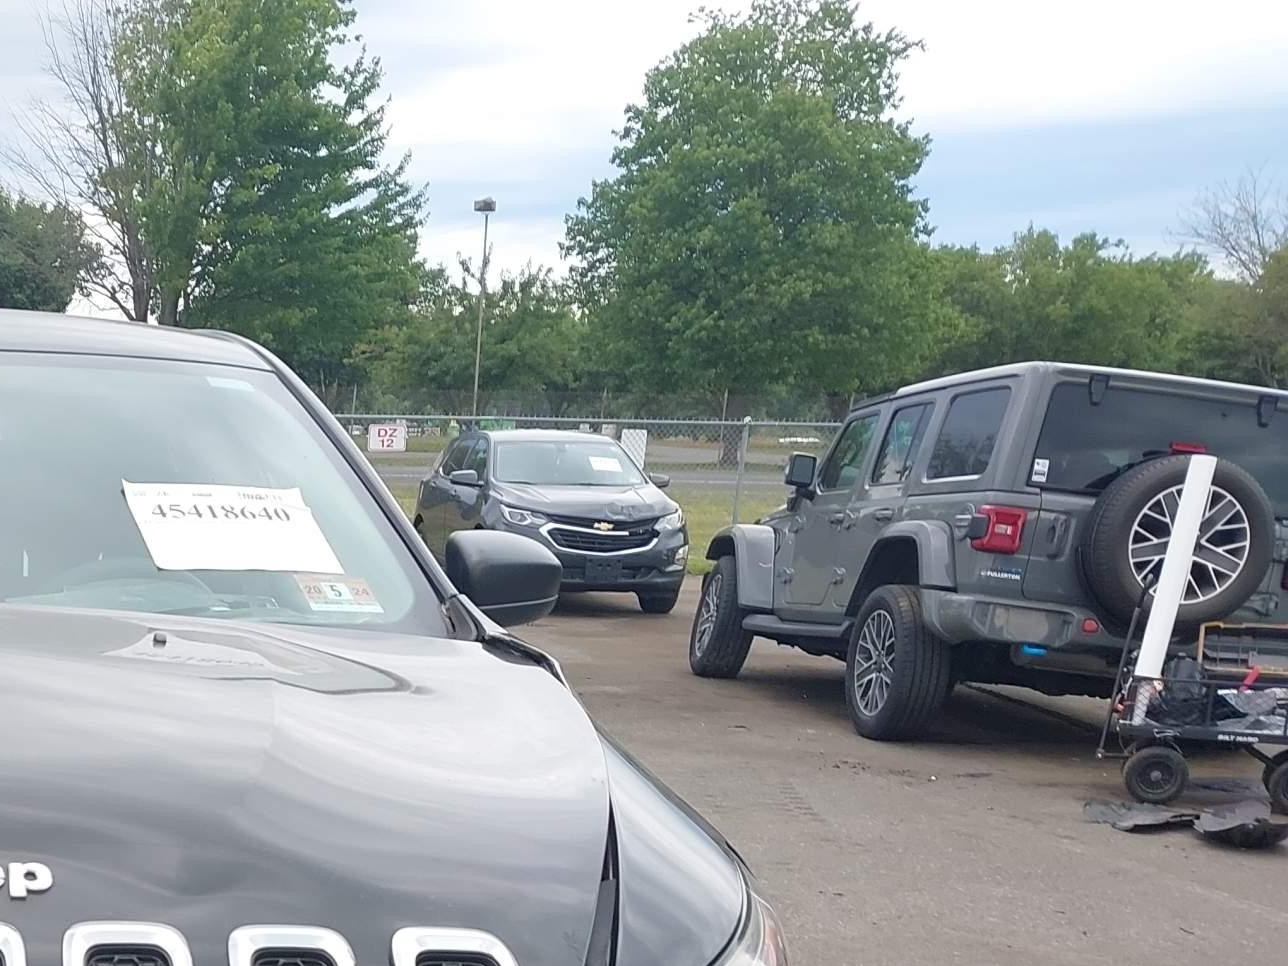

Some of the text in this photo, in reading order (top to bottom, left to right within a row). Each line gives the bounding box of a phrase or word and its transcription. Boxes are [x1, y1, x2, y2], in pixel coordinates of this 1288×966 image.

[377, 428, 398, 437] DZ
[379, 438, 394, 448] 12
[151, 504, 291, 522] 45418640
[328, 584, 342, 597] 5
